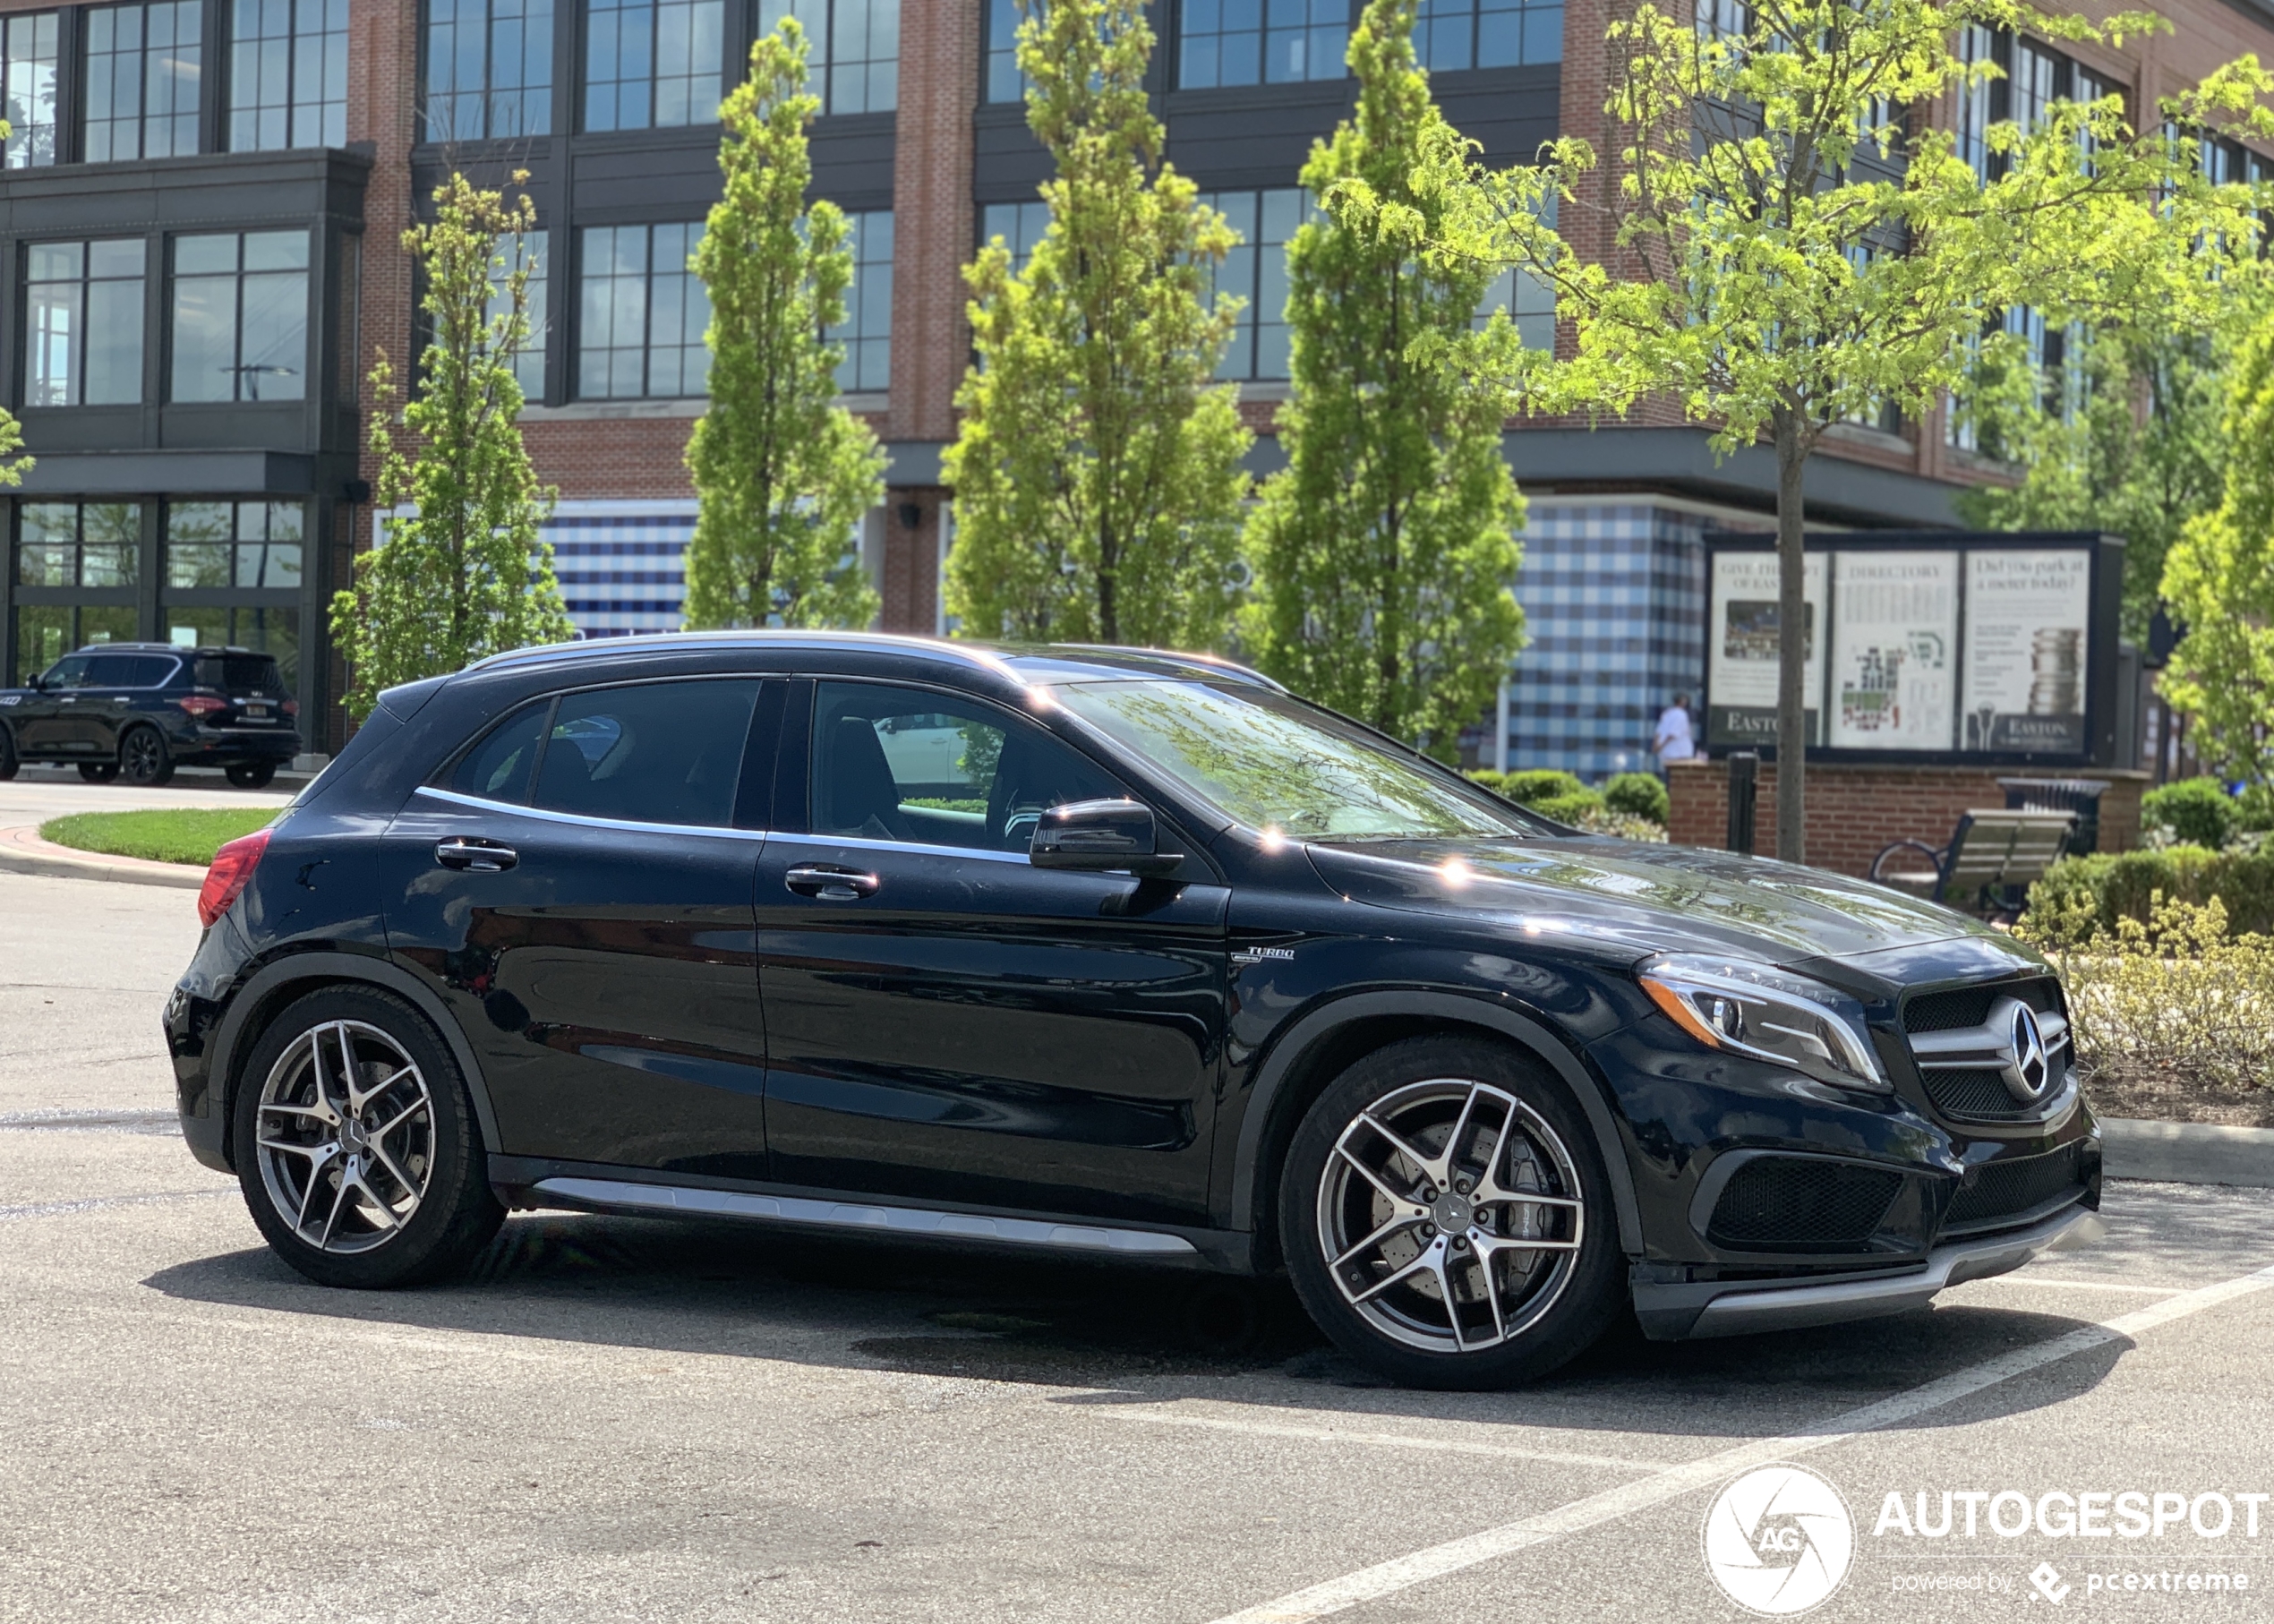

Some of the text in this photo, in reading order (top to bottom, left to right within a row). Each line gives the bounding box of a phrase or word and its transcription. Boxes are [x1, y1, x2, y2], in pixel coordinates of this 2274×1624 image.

[1721, 563, 1751, 575] GIVE
[1757, 563, 1780, 576] TH
[1849, 565, 1941, 579] DIRECTORY
[1976, 558, 2005, 573] Did
[2035, 558, 2066, 577] park
[1987, 577, 2027, 591] meter
[2030, 575, 2076, 594] today?
[1248, 946, 1295, 957] TURBO
